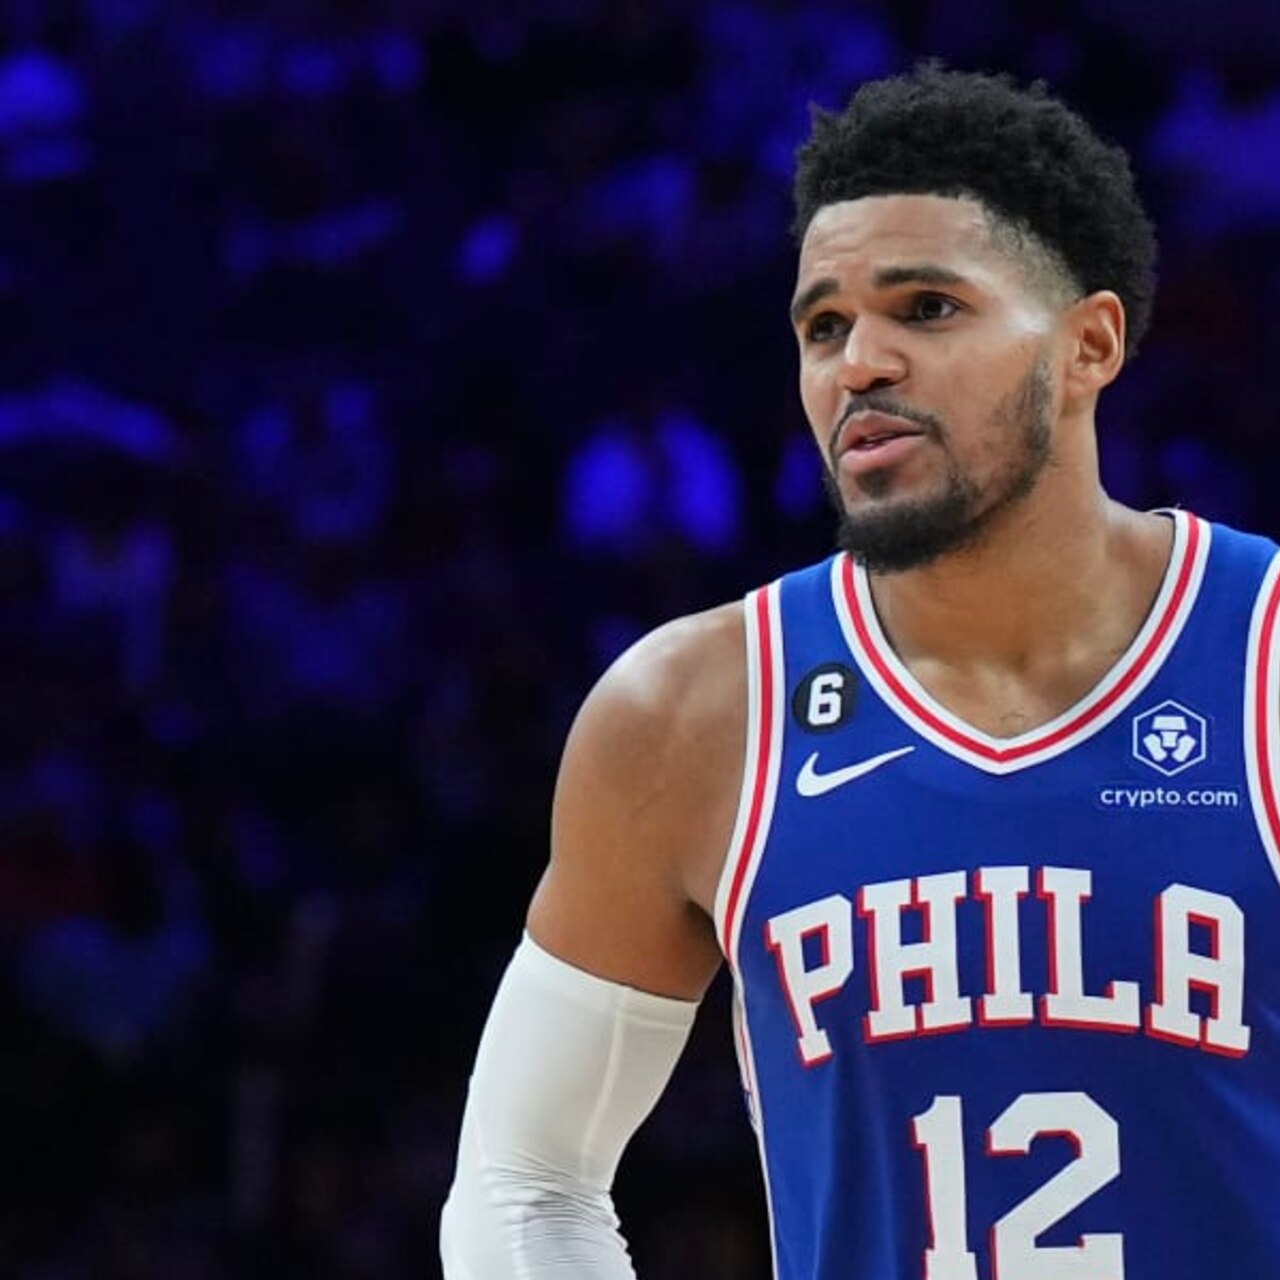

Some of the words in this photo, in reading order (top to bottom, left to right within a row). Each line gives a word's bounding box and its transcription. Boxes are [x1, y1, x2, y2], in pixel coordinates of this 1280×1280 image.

[808, 672, 844, 725] 6
[1101, 786, 1238, 809] crypto.com
[764, 864, 1251, 1067] PHILA
